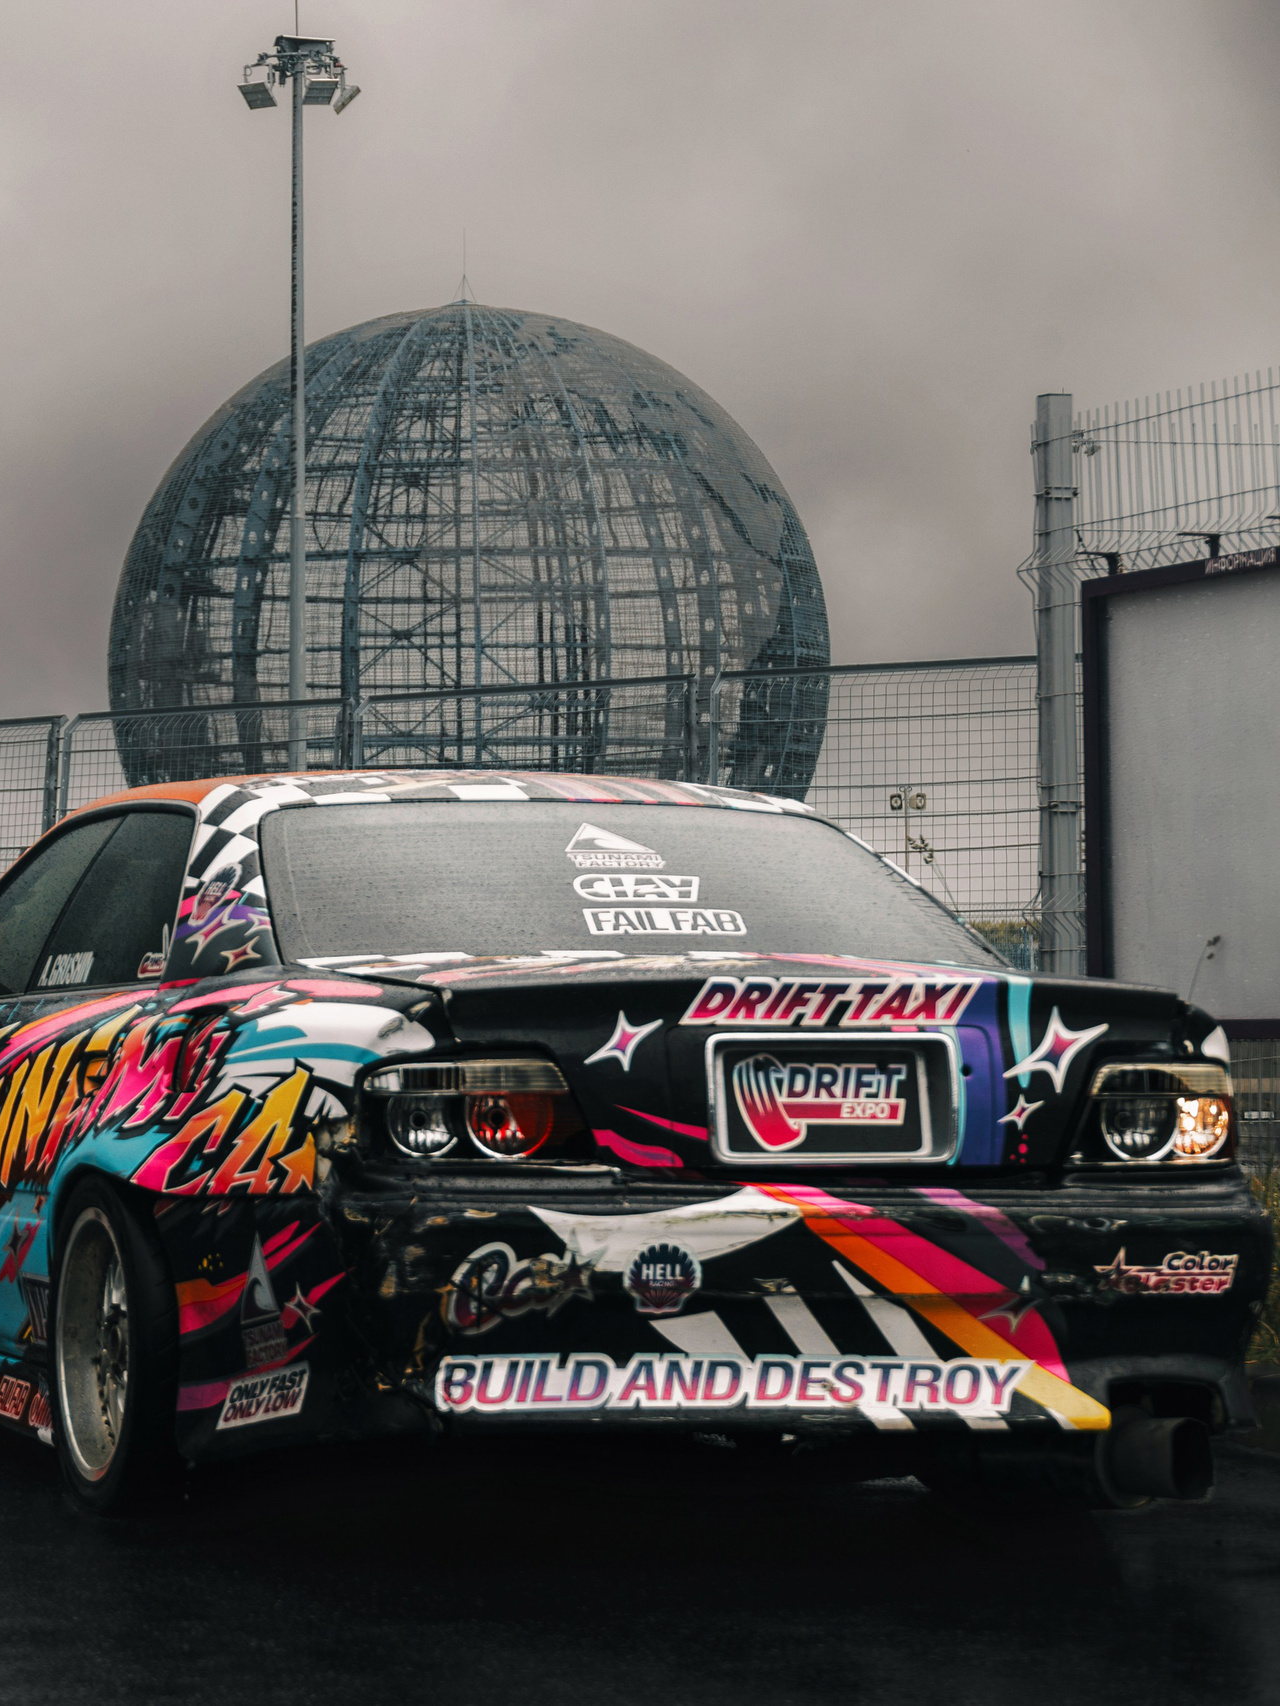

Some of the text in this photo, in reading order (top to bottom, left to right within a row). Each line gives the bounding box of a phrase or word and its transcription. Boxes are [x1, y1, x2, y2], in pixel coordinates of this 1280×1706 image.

[570, 853, 660, 861] TSUNAMI
[578, 860, 665, 868] FACTORY
[848, 981, 974, 1021] TAXI
[786, 1064, 904, 1099] DRIFT
[841, 1102, 891, 1119] EXPO
[641, 1263, 685, 1280] HELL
[1166, 1252, 1234, 1272] Color
[228, 1369, 307, 1404] ONLY FAST
[442, 1359, 1020, 1406] BUILD AND DESTROY
[223, 1388, 303, 1423] ONLY LOW
